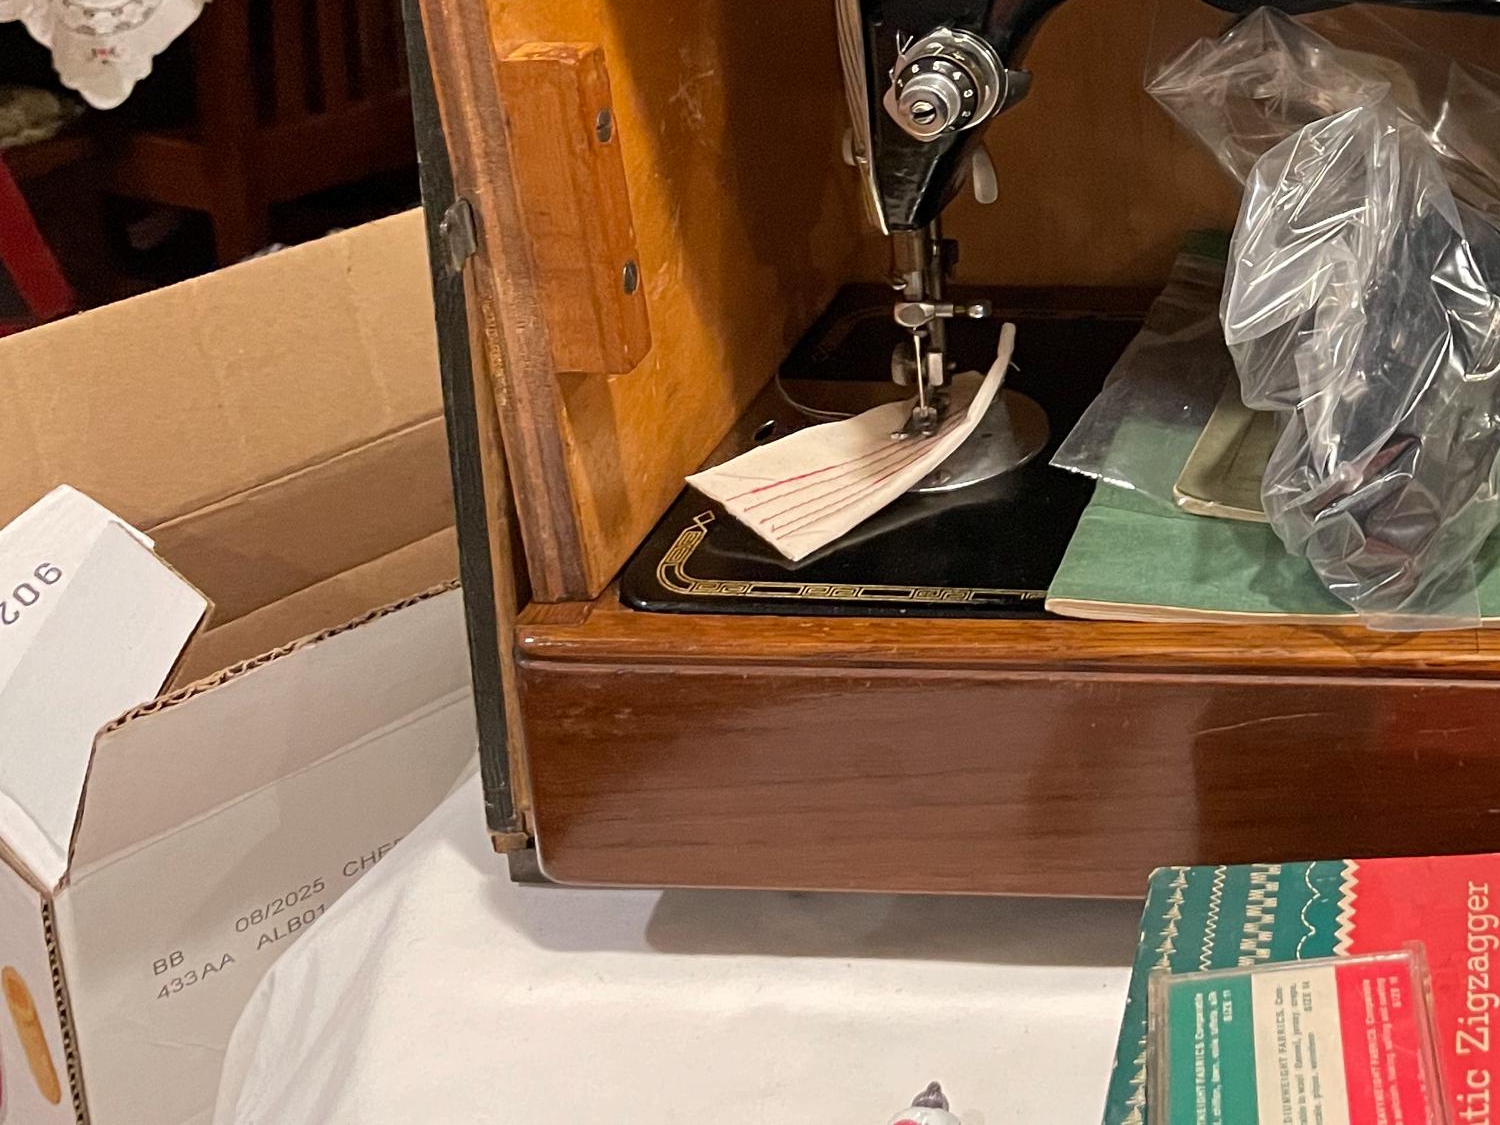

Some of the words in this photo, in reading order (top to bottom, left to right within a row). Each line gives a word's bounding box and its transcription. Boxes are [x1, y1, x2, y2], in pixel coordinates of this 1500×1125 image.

[152, 950, 185, 976] BB
[235, 877, 326, 933] 08/2025
[157, 952, 236, 1000] 433AA
[256, 903, 326, 951] ALB01
[1456, 881, 1500, 1055] Zigzagger
[1302, 991, 1313, 1013] SIZE
[1278, 1056, 1293, 1125] DIUMWEIGHT
[1456, 1069, 1491, 1125] tic
